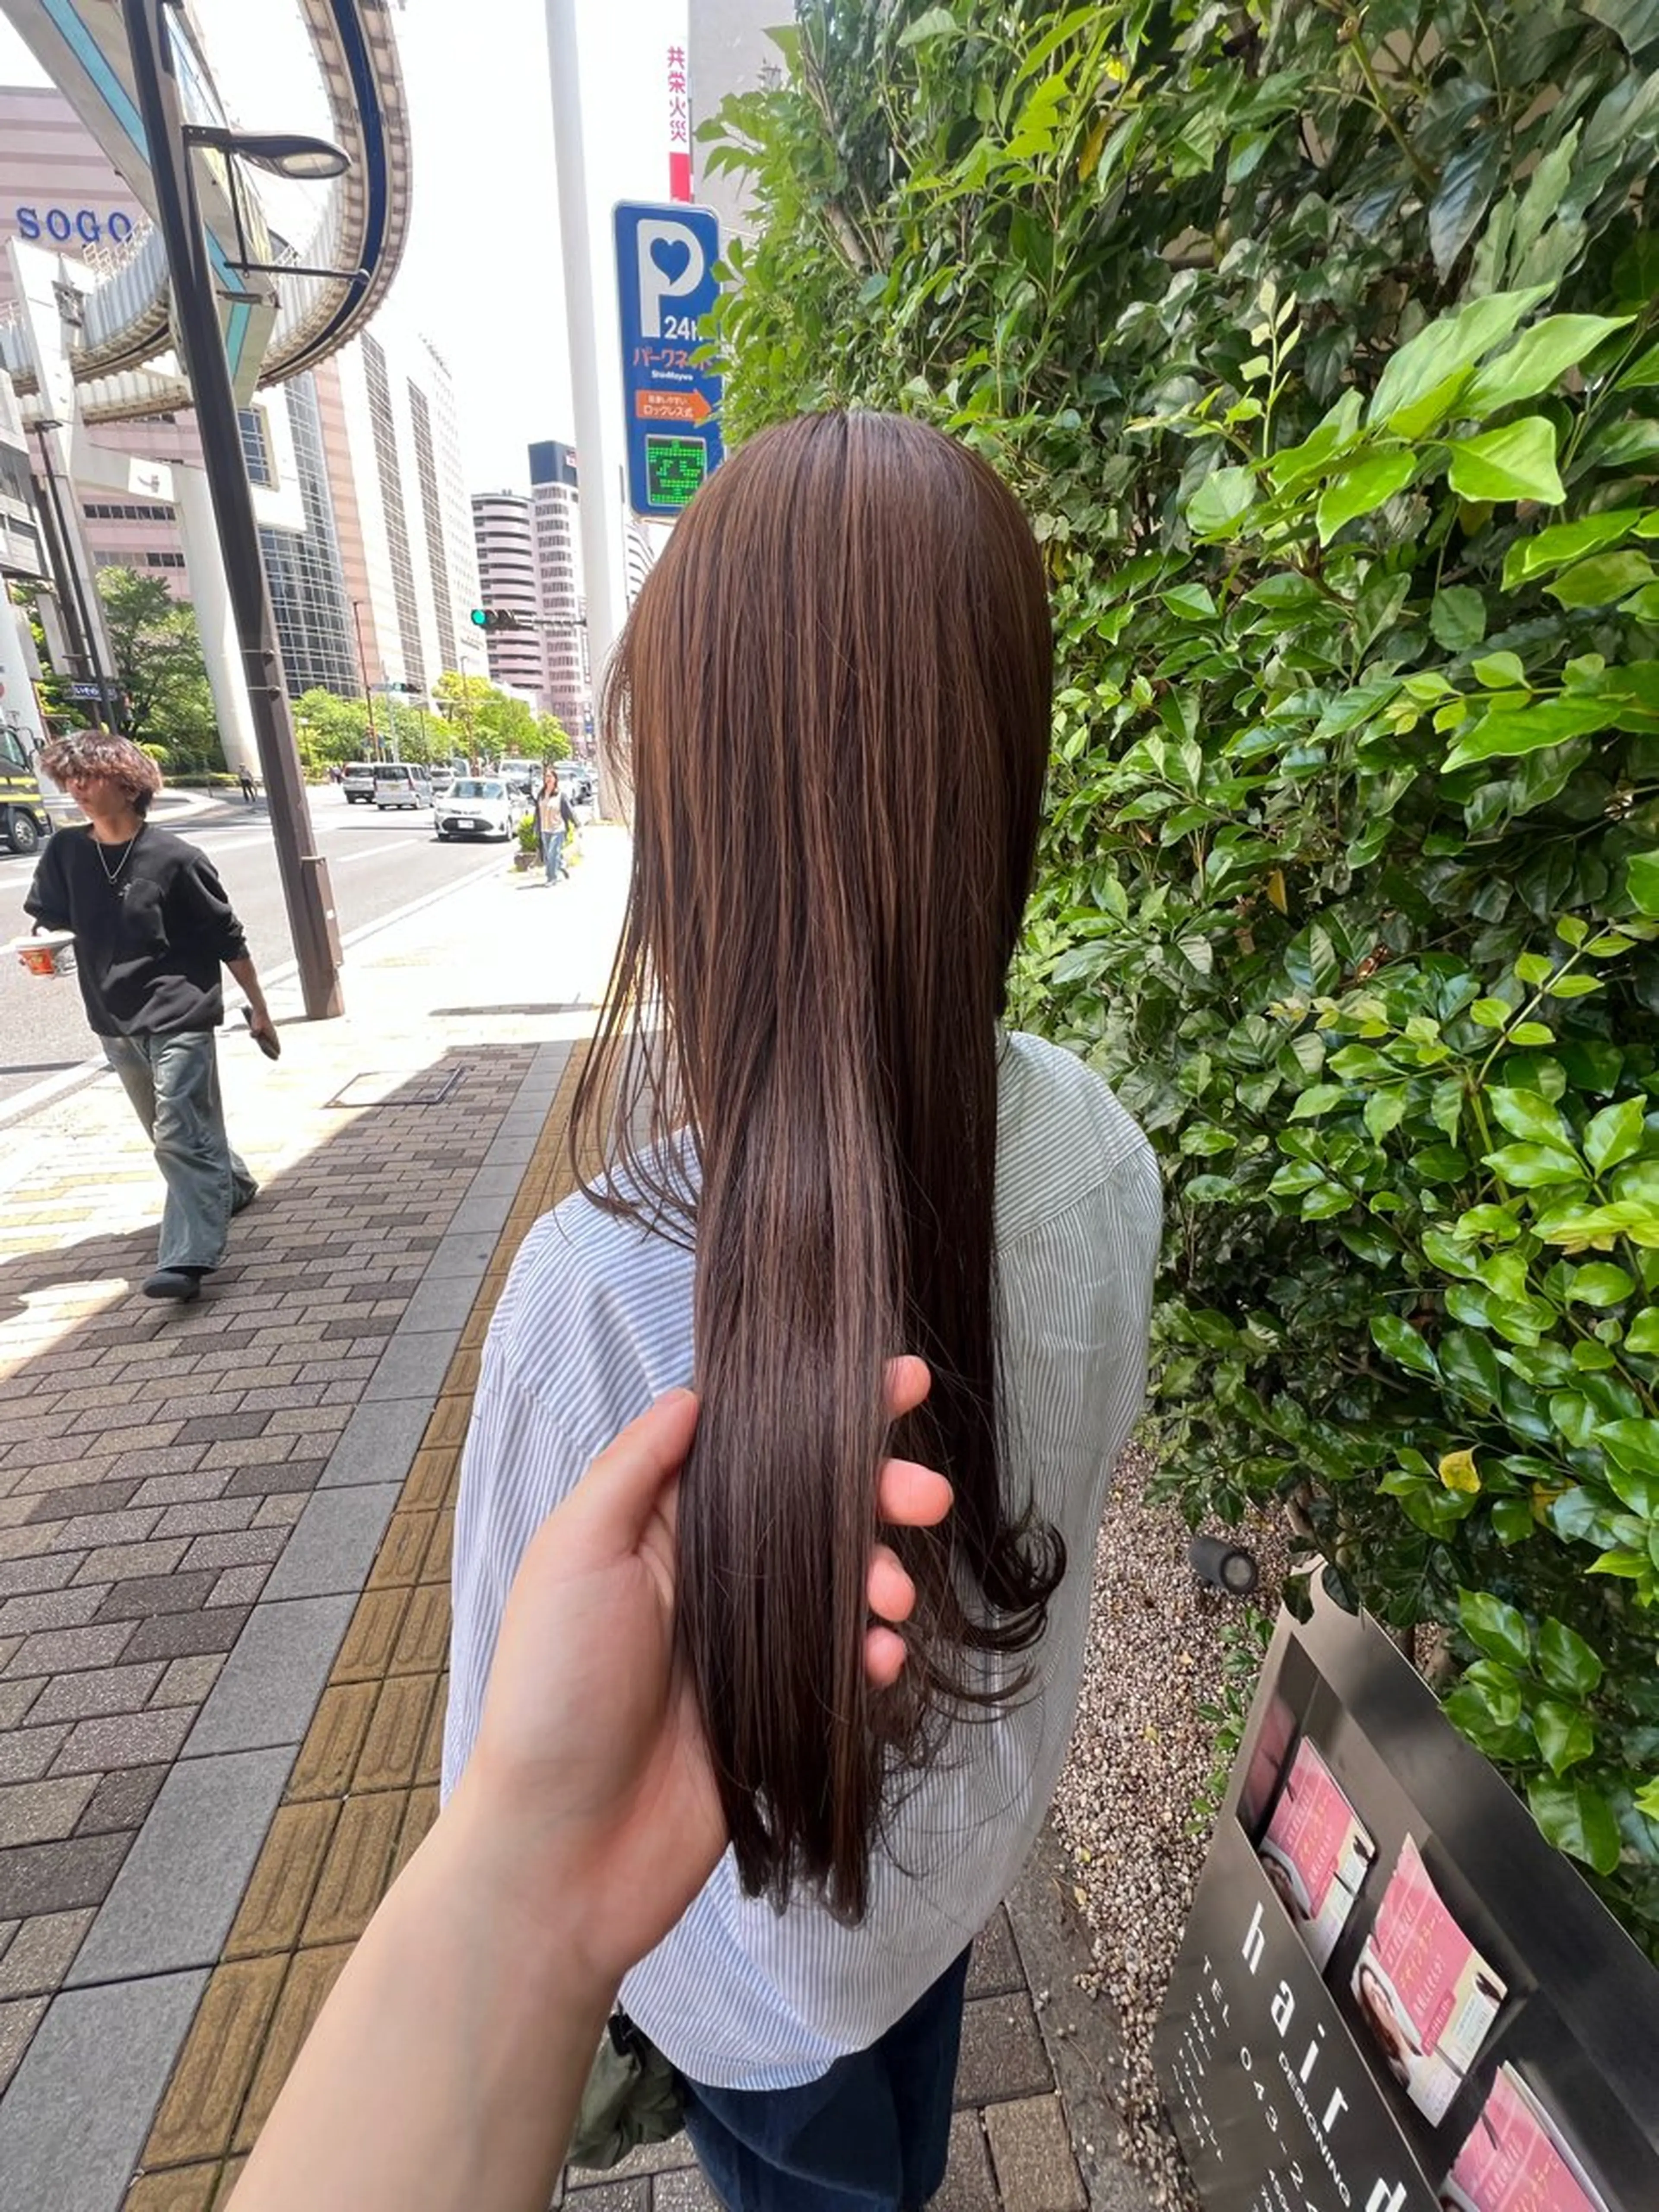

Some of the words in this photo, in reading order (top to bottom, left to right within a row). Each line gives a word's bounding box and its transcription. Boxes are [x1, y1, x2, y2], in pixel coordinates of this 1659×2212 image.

[667, 46, 687, 143] 共栄火災
[16, 207, 132, 243] SOGO
[637, 219, 704, 338] P
[1203, 1955, 1230, 2028] TEL
[1241, 1900, 1349, 2133] hair
[1278, 2051, 1351, 2208] DESIGNING
